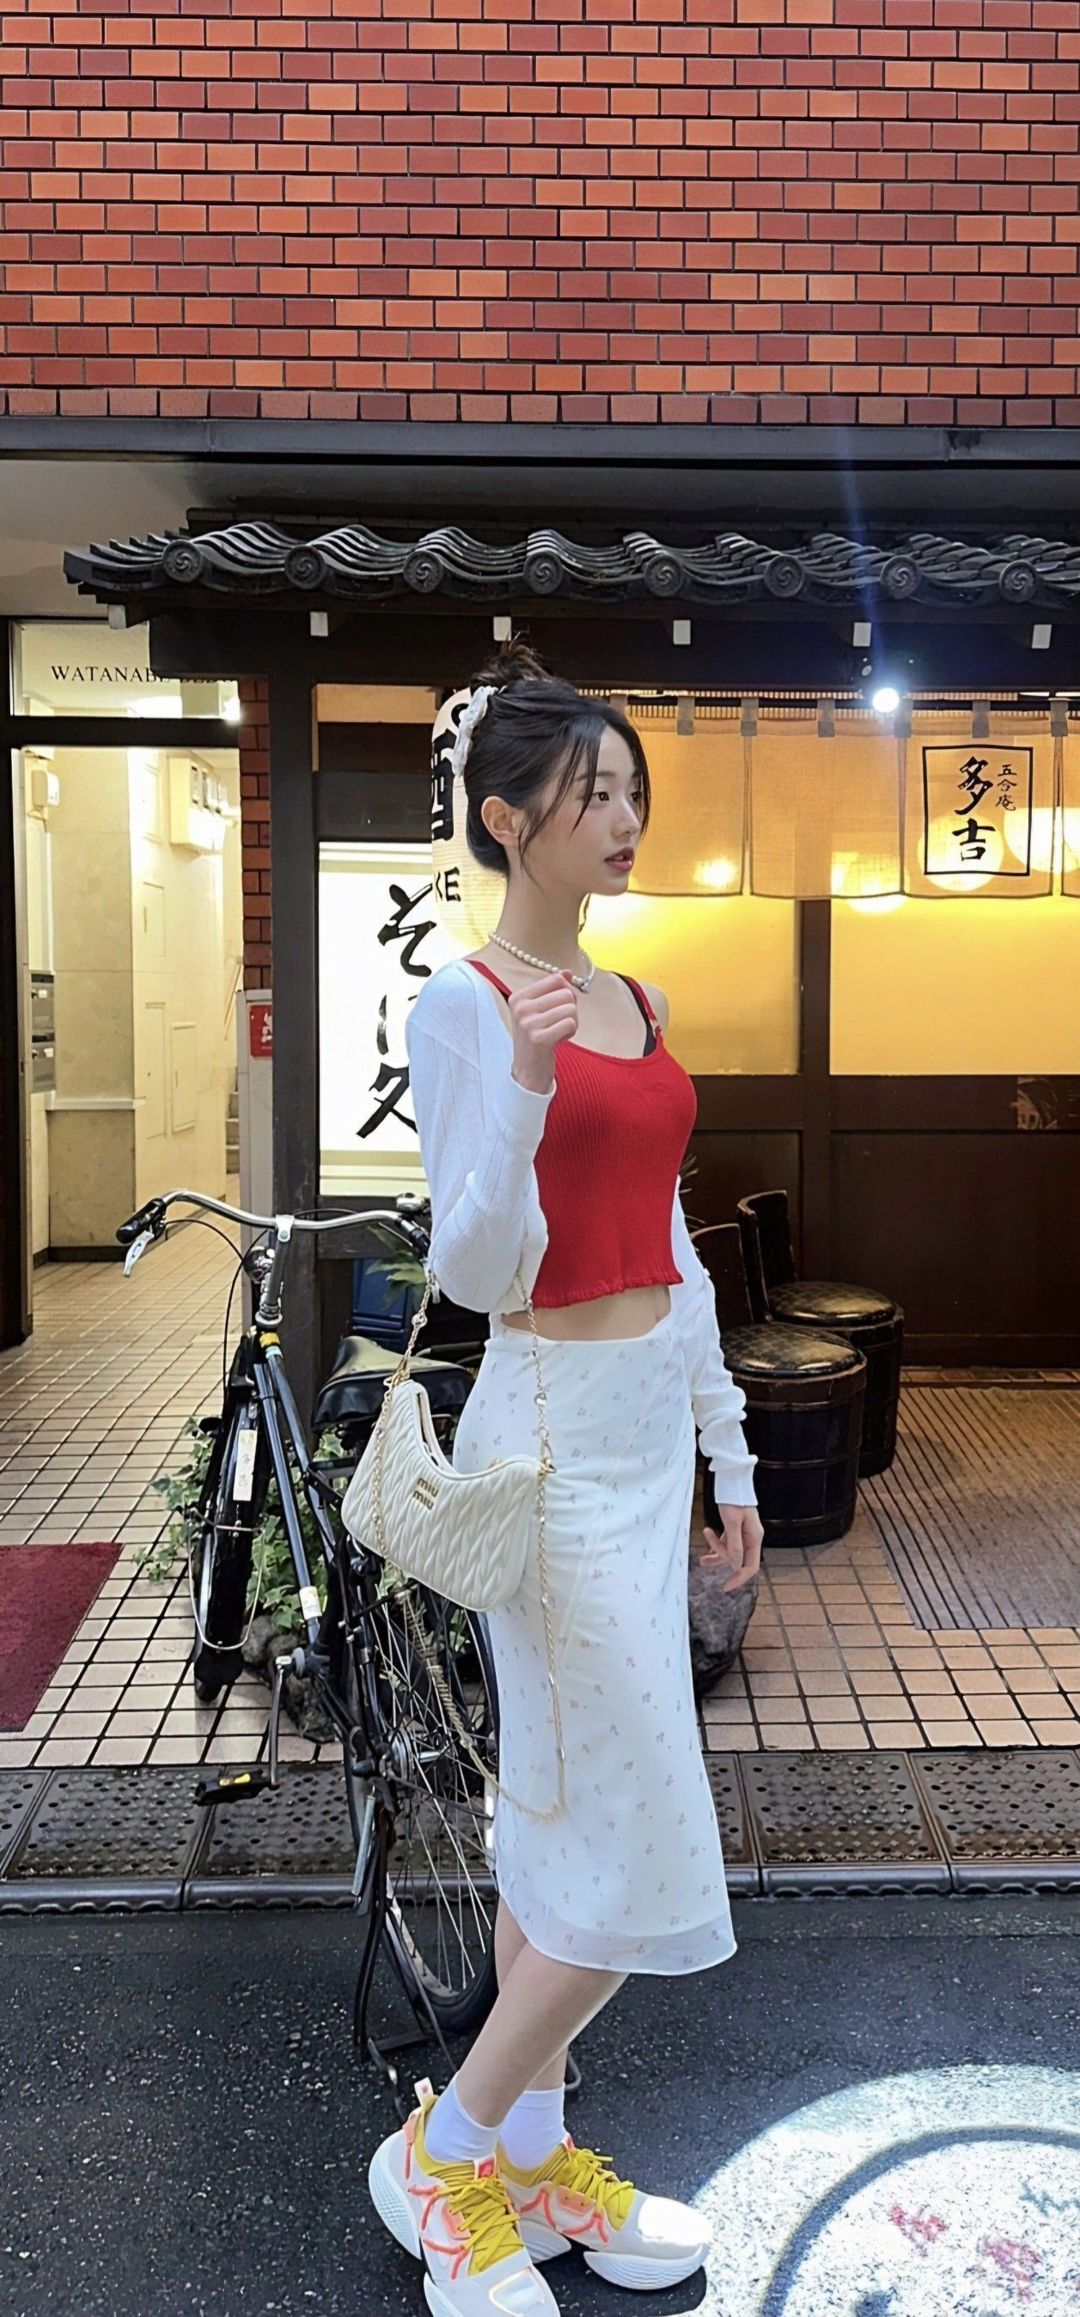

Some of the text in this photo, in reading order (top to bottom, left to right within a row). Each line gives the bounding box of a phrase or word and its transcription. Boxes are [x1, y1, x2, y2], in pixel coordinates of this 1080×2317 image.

[952, 756, 996, 861] 多吉
[417, 1478, 439, 1498] miu
[412, 1490, 434, 1510] miu
